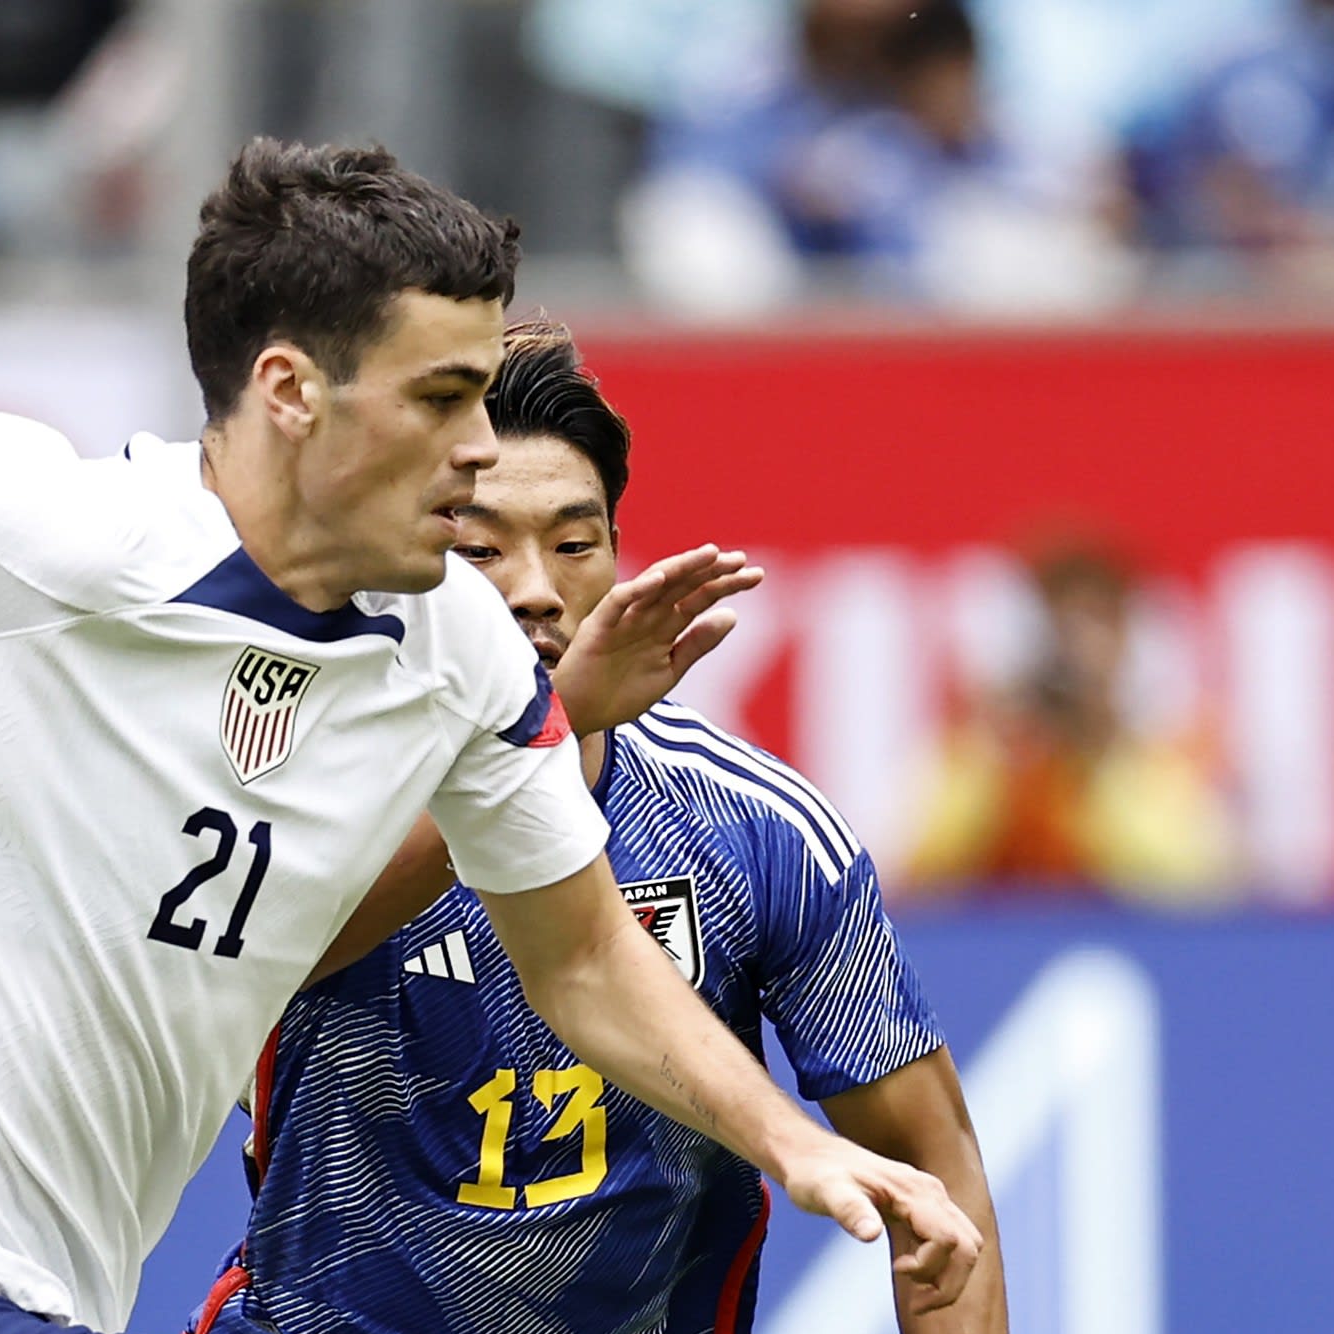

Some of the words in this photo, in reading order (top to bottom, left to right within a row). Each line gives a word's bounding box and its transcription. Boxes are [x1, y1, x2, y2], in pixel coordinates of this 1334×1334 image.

[237, 653, 310, 705] USA
[147, 806, 272, 959] 21
[623, 884, 668, 901] APAN
[456, 1064, 608, 1210] 13
